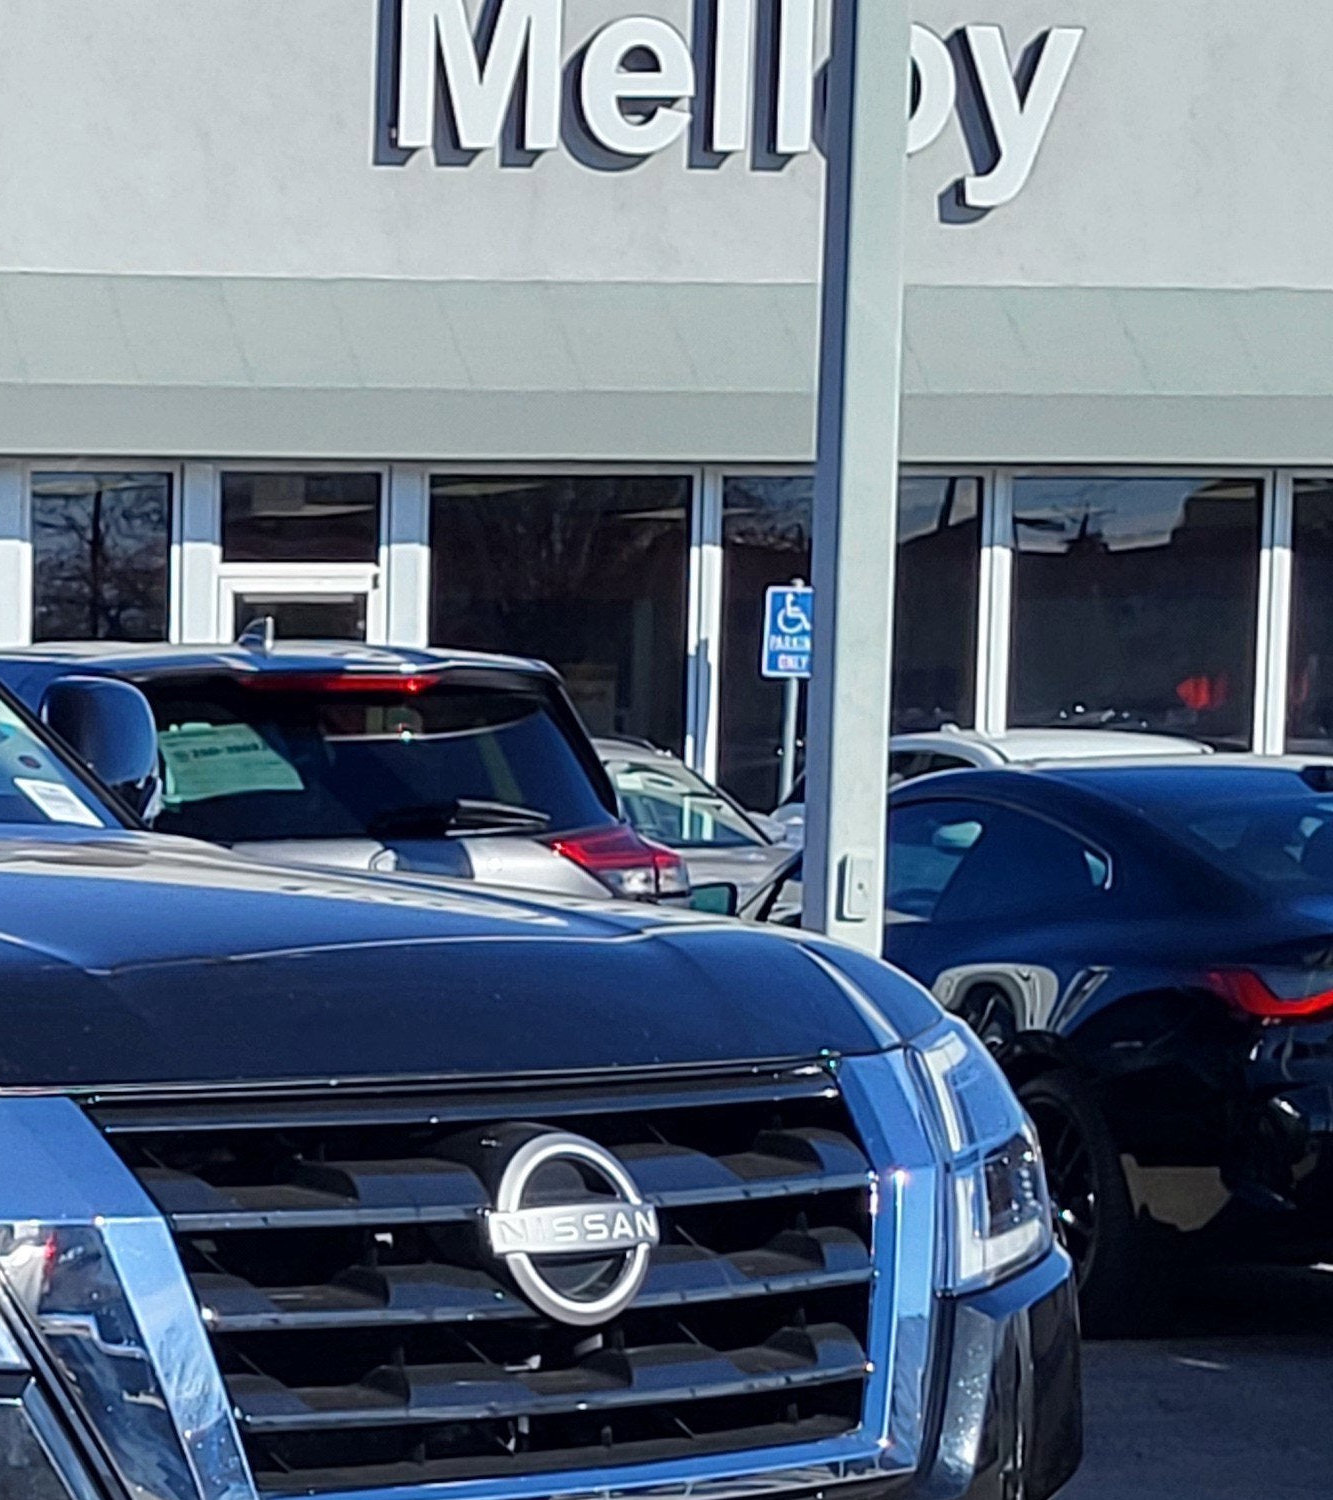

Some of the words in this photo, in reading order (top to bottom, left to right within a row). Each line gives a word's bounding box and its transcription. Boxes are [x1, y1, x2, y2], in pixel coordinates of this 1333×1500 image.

[770, 634, 811, 651] PARKIN
[778, 654, 810, 670] ONLY
[499, 1211, 656, 1243] NISSAN
